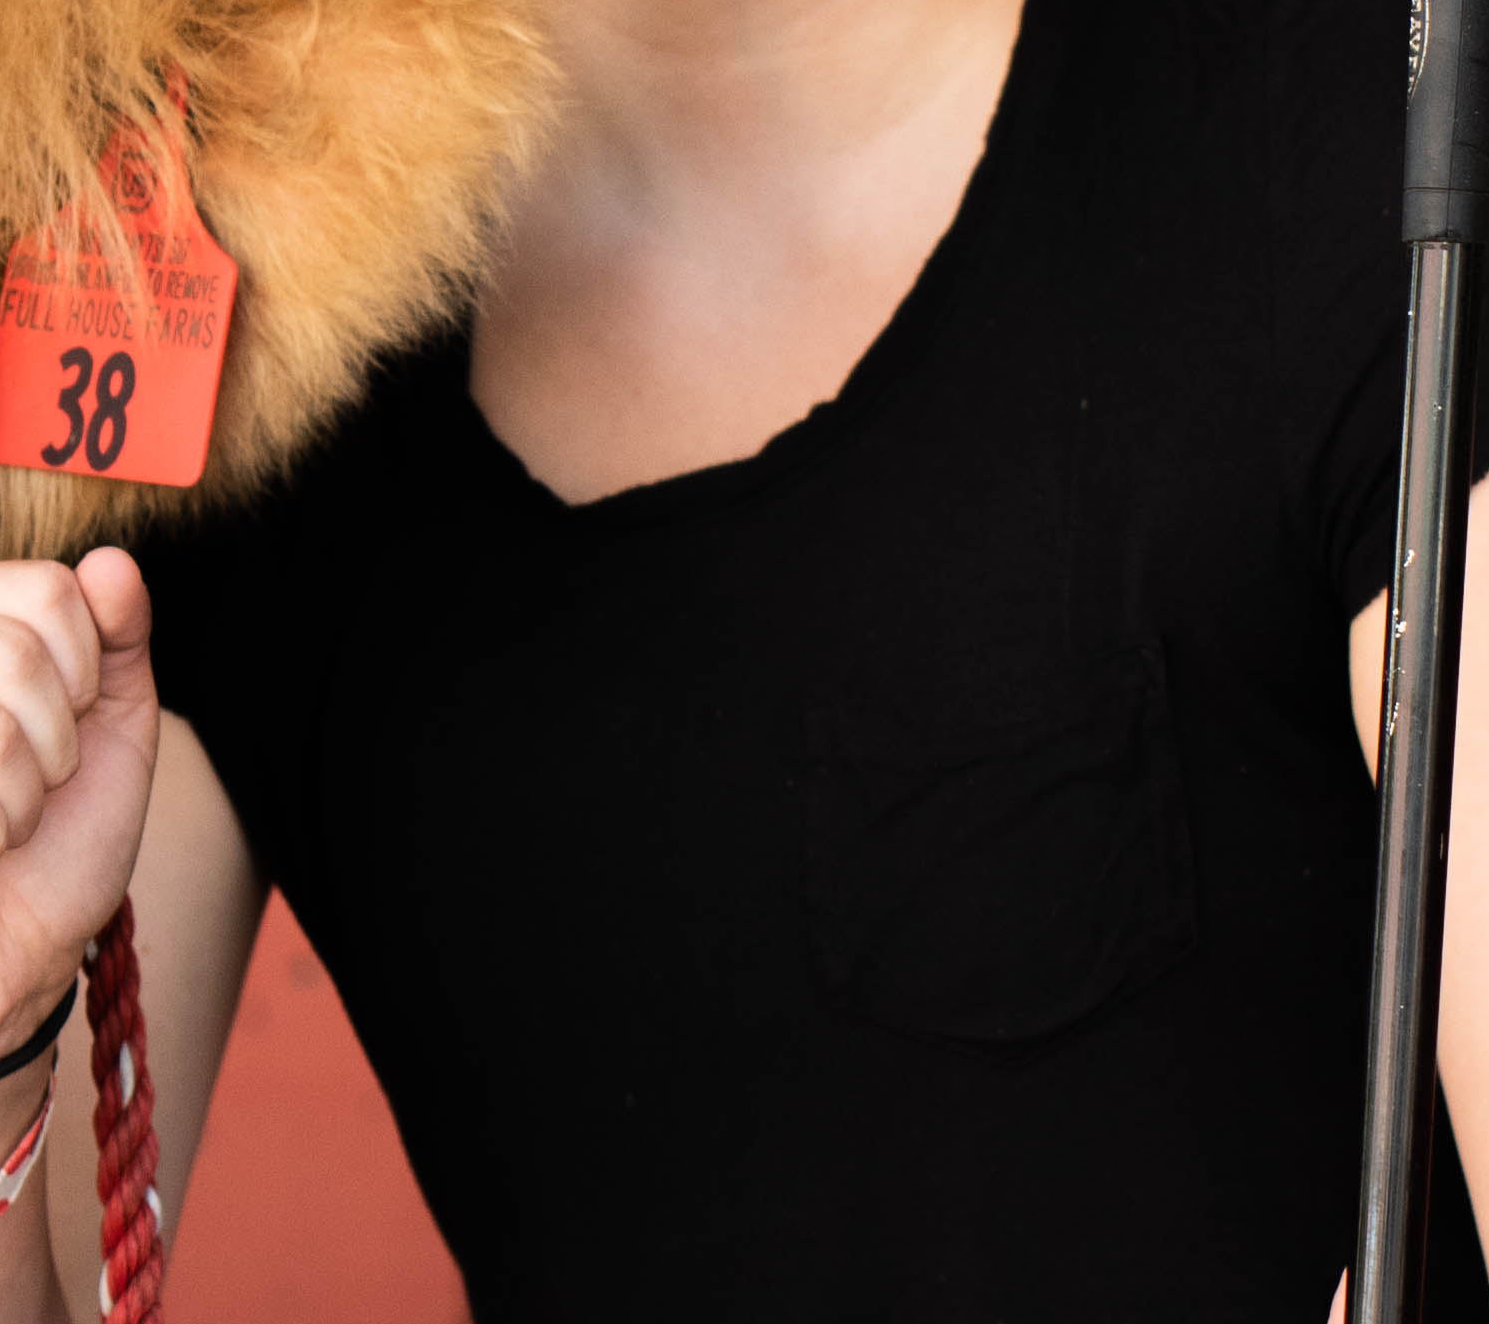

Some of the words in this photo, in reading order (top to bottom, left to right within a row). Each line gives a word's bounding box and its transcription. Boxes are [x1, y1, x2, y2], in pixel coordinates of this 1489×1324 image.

[0, 287, 54, 332] FULL
[65, 297, 134, 341] HOUSE
[144, 305, 217, 349] FARMS
[40, 346, 136, 472] 38
